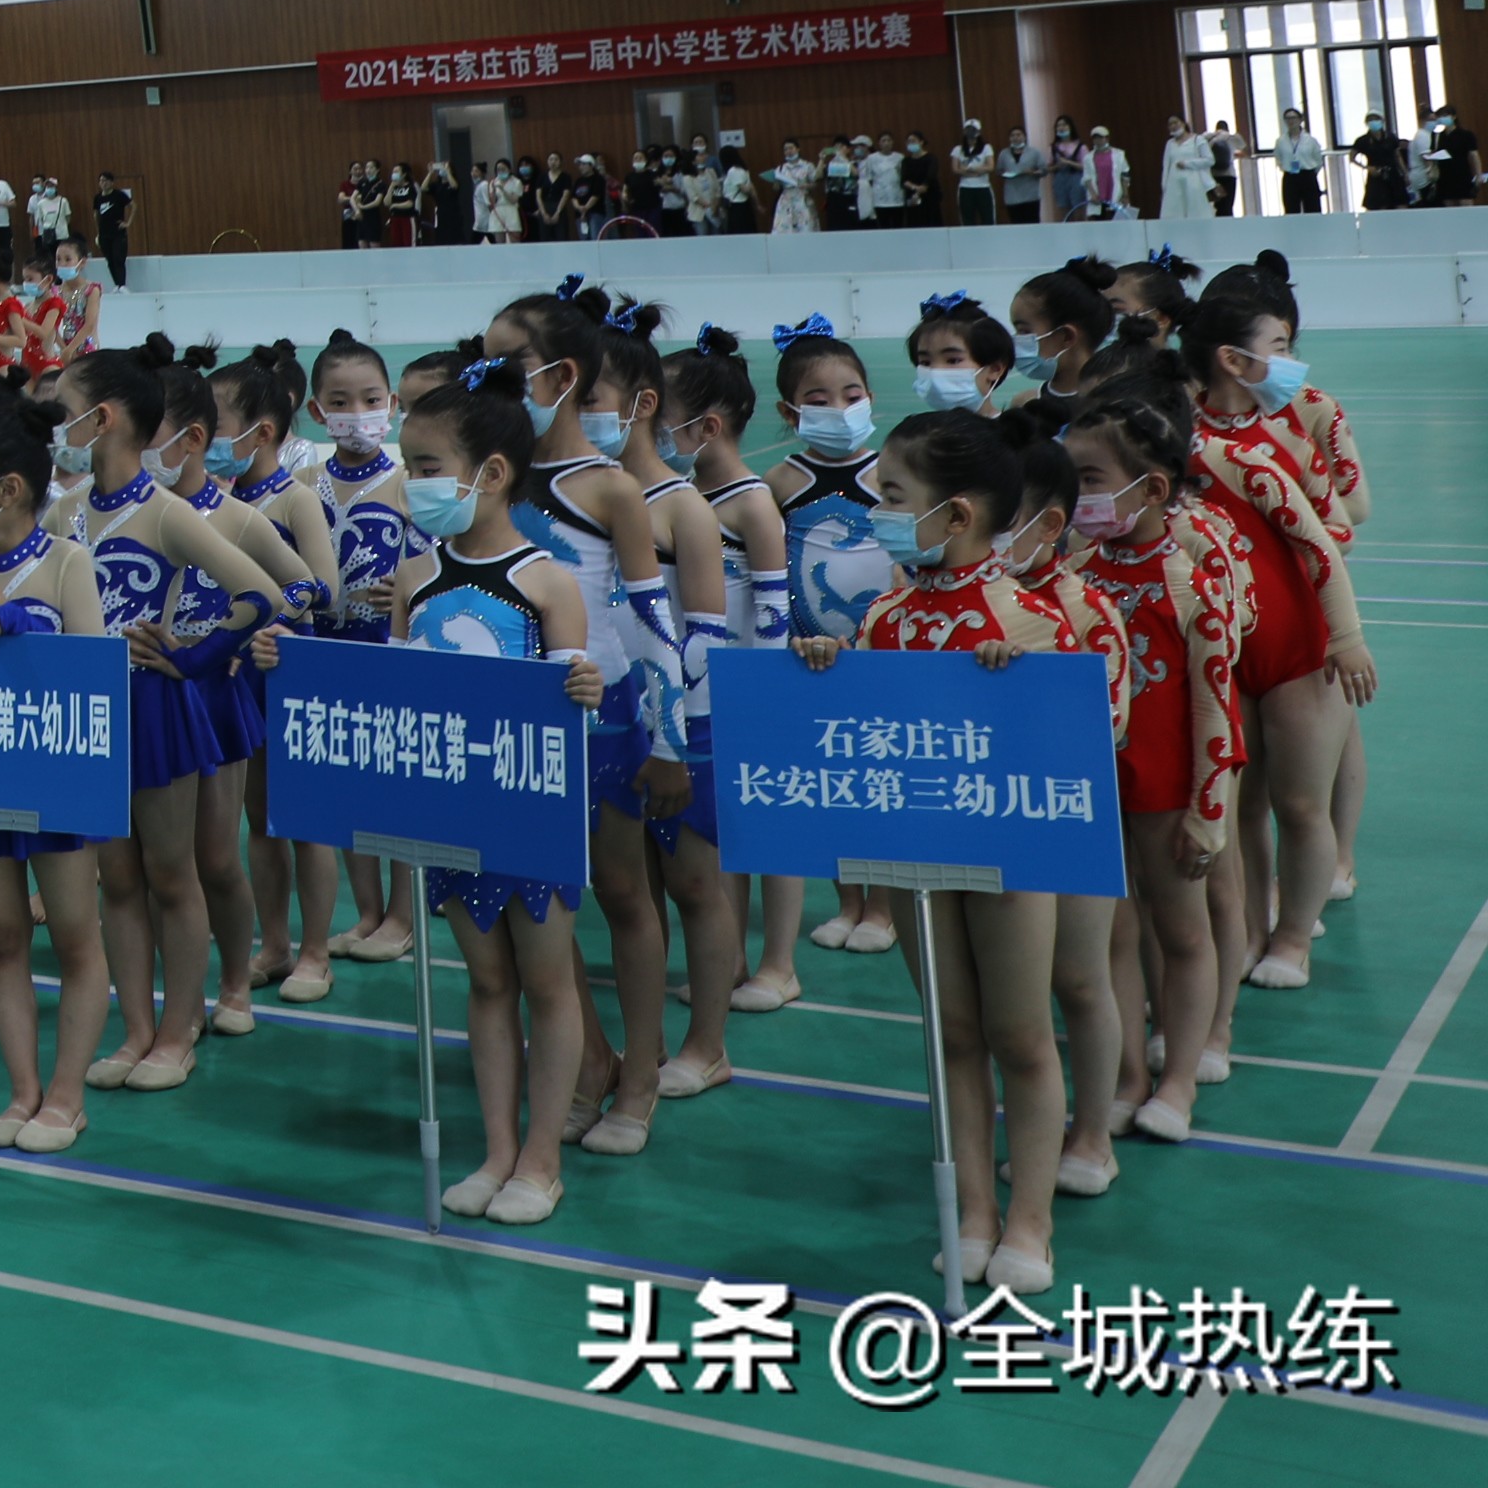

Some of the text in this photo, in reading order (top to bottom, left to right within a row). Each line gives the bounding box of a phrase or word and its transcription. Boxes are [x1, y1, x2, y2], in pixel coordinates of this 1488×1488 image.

[344, 12, 912, 89] 2021年石家庄市第一届中小学生艺术体操比赛
[283, 696, 566, 797] 石家庄市裕华区第一幼儿园
[814, 716, 993, 764] 石家庄市
[733, 763, 1093, 823] 长安区第三幼儿园
